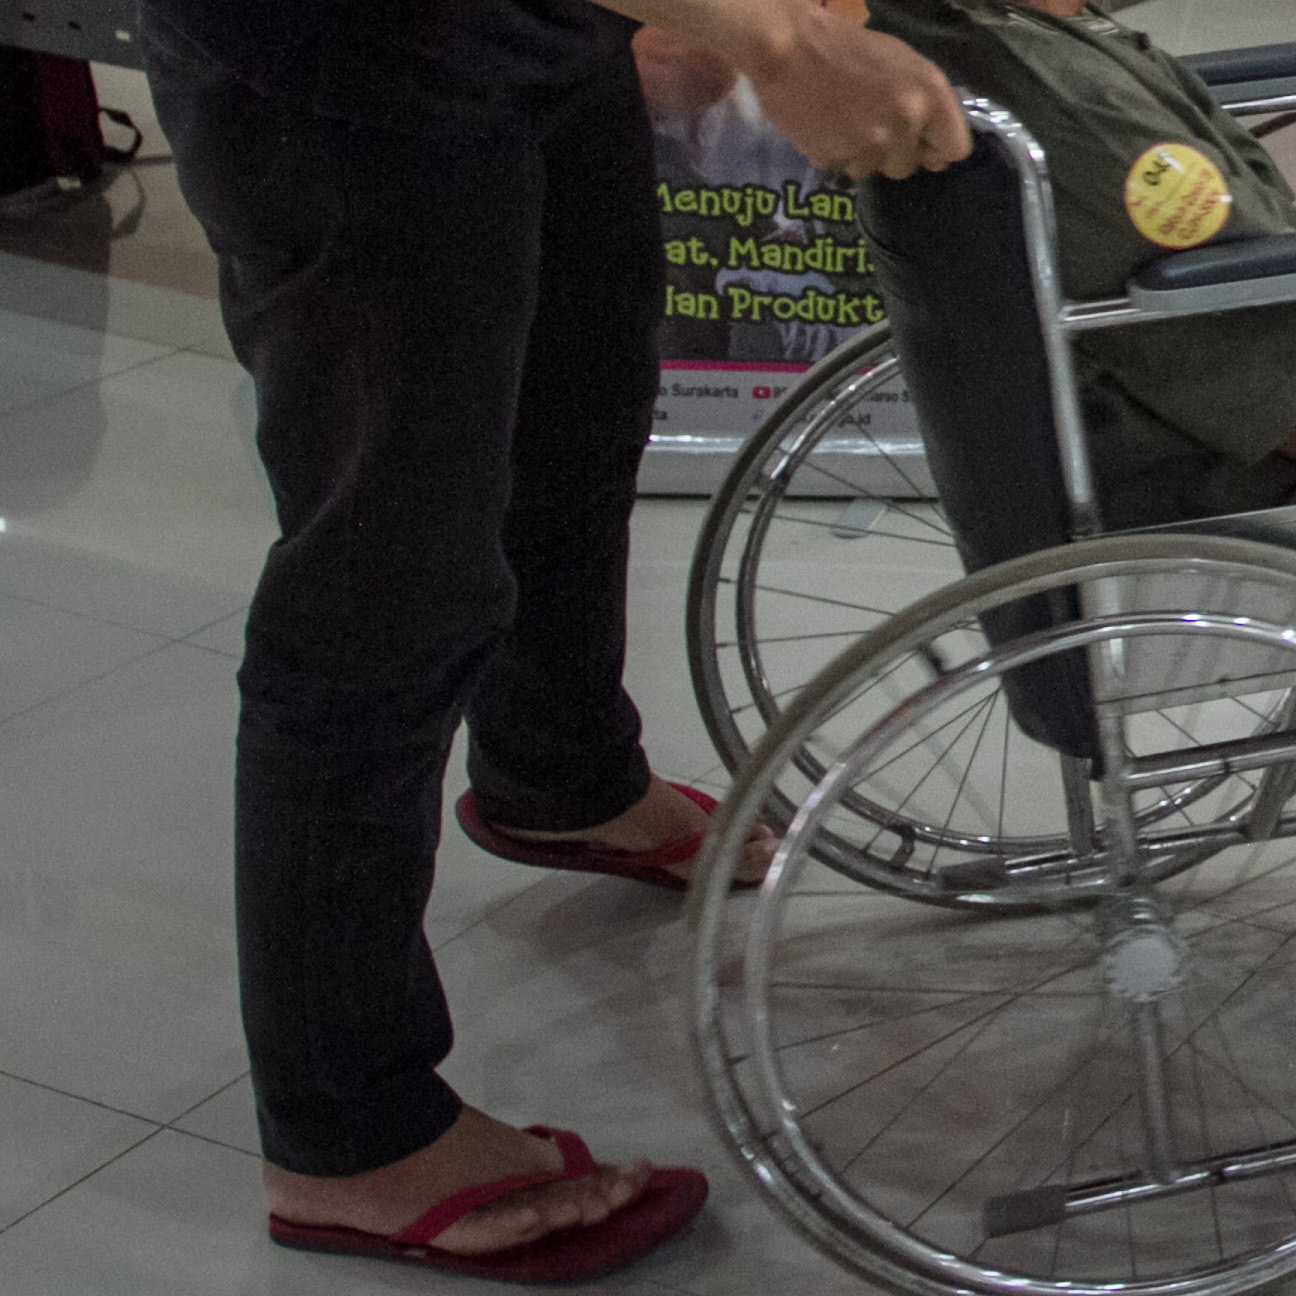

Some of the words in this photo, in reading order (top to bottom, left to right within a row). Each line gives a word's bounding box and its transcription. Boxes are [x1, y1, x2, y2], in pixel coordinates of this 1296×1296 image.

[786, 184, 854, 221] Lan
[727, 286, 885, 324] Produkt
[671, 383, 739, 399] Surakarta
